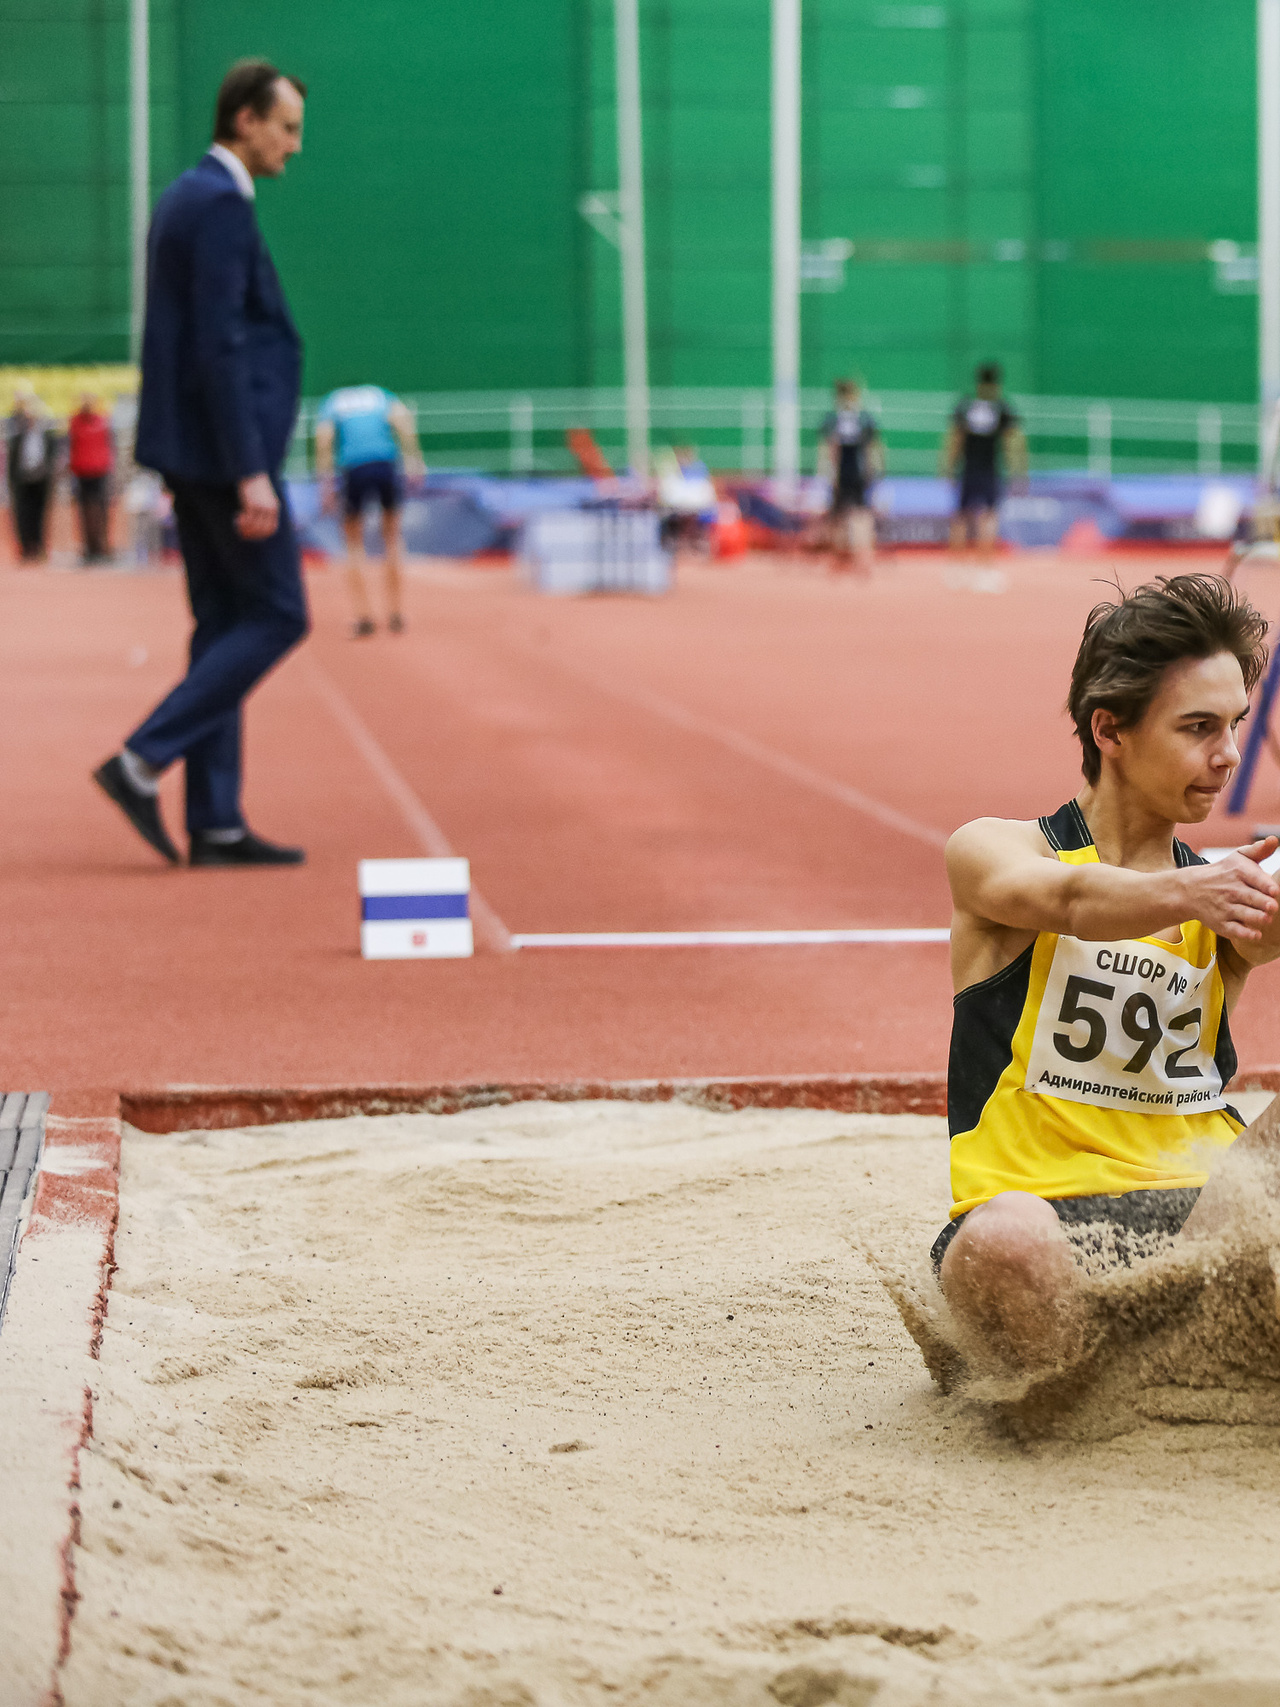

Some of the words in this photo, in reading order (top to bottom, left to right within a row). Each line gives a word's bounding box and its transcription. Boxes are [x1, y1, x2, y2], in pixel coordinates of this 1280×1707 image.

[1096, 949, 1166, 983] СШОР
[1167, 971, 1188, 996] №
[1052, 974, 1204, 1079] 592
[1038, 1070, 1174, 1105] Адмиралтейский
[1176, 1089, 1211, 1107] район
